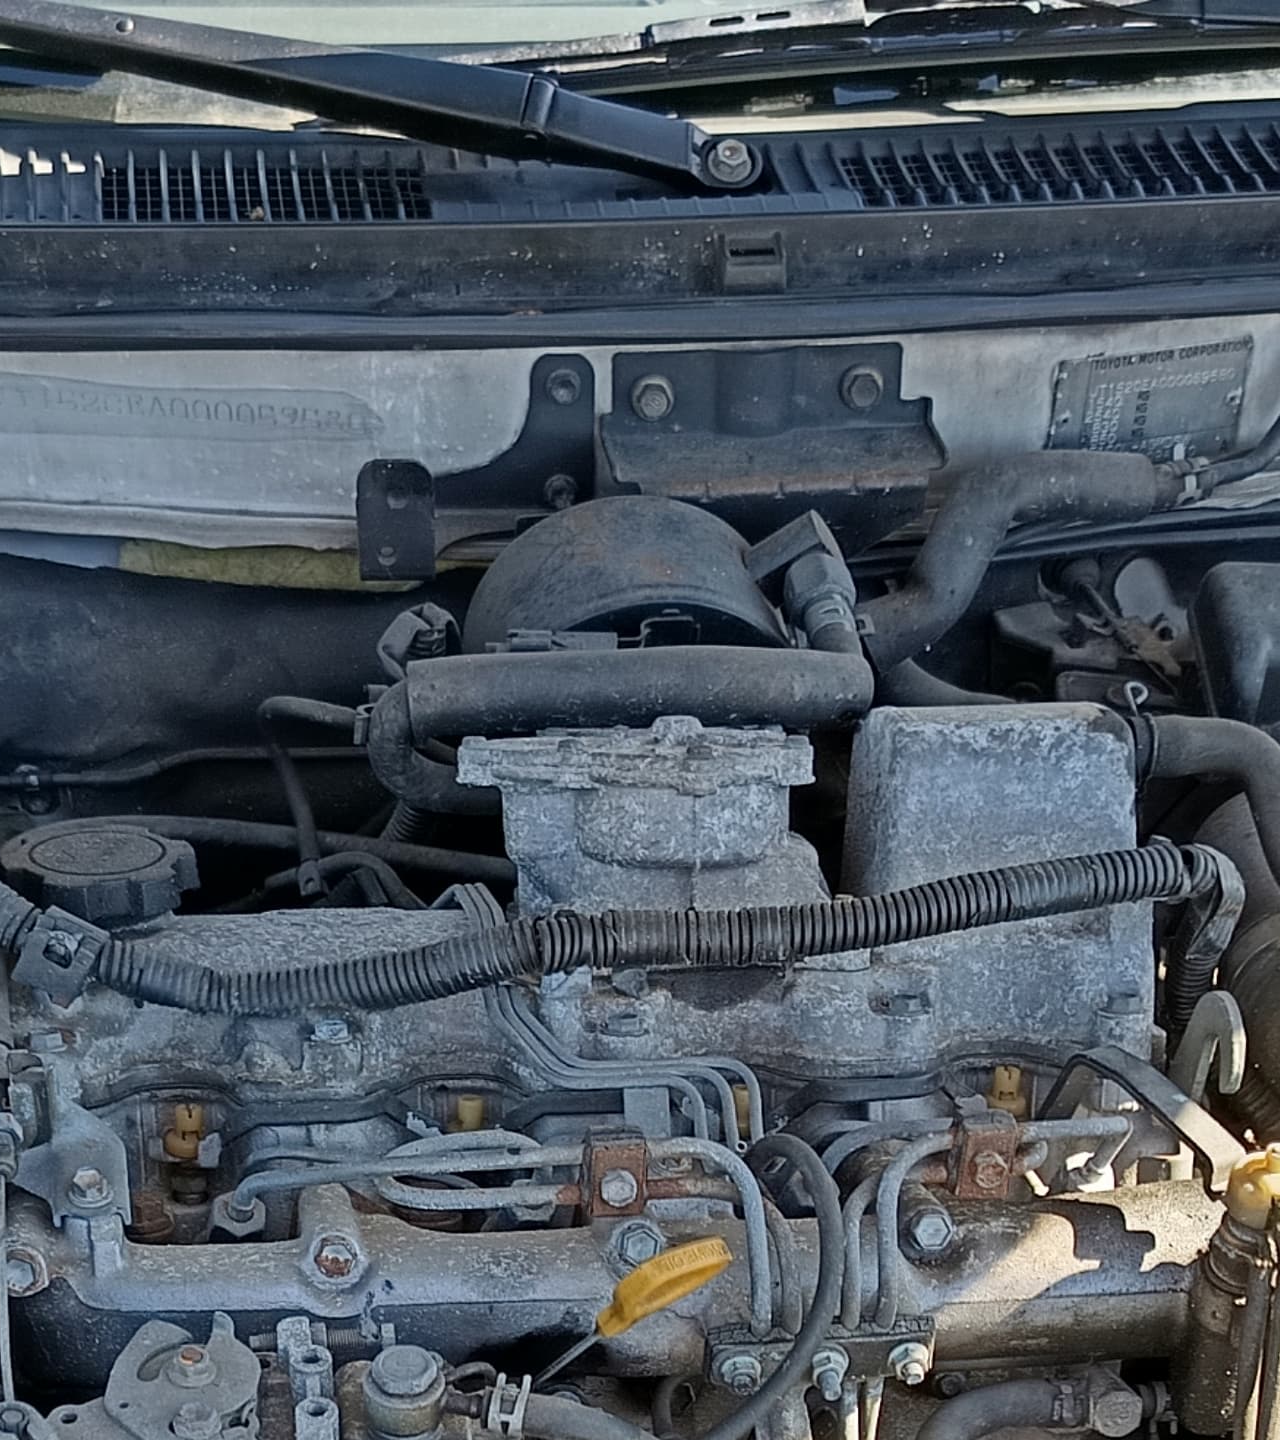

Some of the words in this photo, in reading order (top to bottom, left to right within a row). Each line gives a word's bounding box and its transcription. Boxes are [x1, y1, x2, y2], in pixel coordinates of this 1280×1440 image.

[1094, 356, 1134, 371] TOYOTA
[1138, 350, 1176, 367] MOTOR
[1179, 340, 1249, 361] CORPORATION
